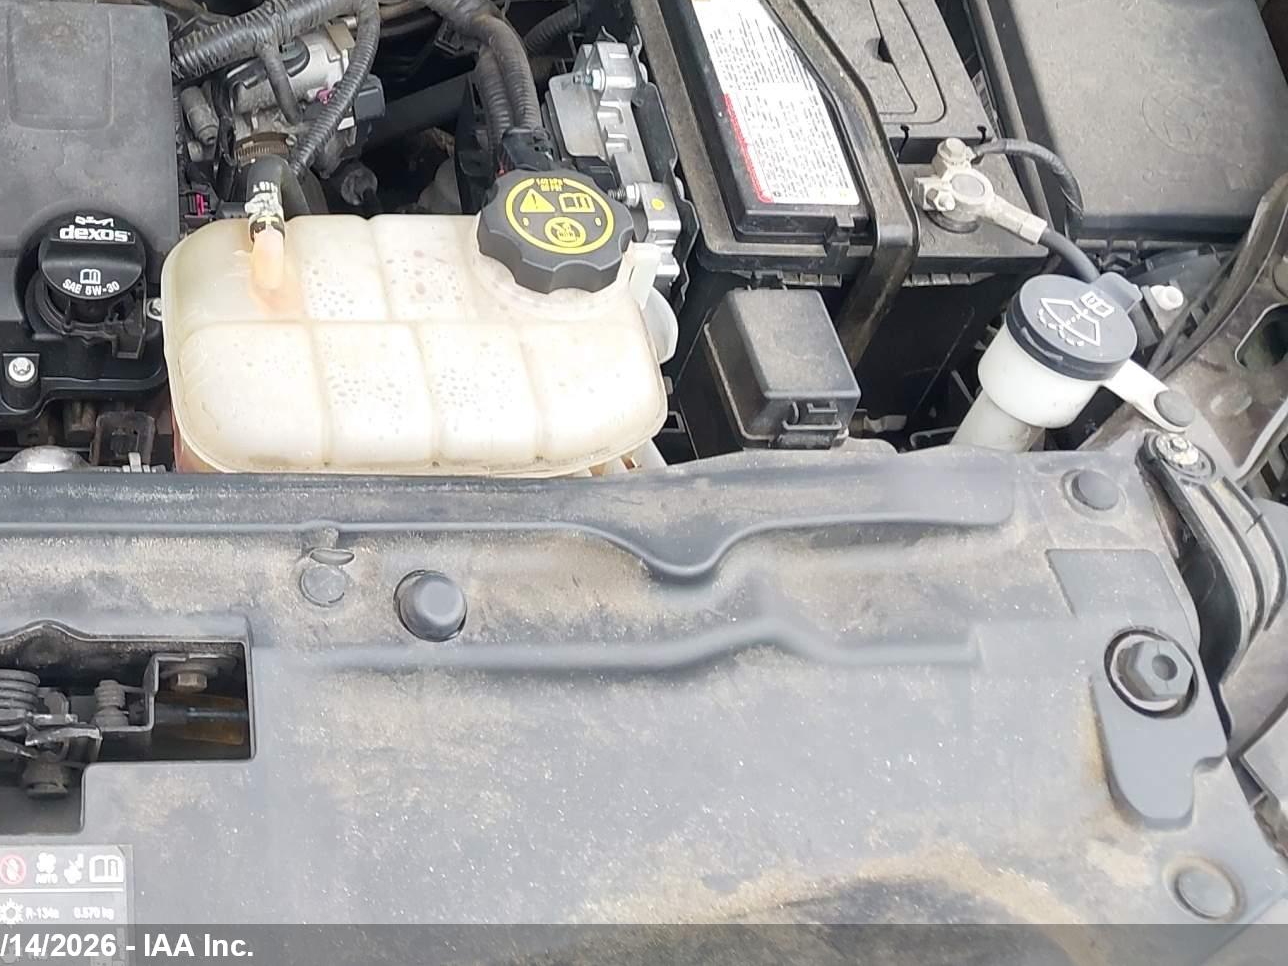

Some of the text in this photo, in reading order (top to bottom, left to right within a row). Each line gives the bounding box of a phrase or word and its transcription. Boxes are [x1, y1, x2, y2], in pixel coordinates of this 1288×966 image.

[59, 224, 129, 242] dexos
[62, 278, 120, 296] SAE 5W-30
